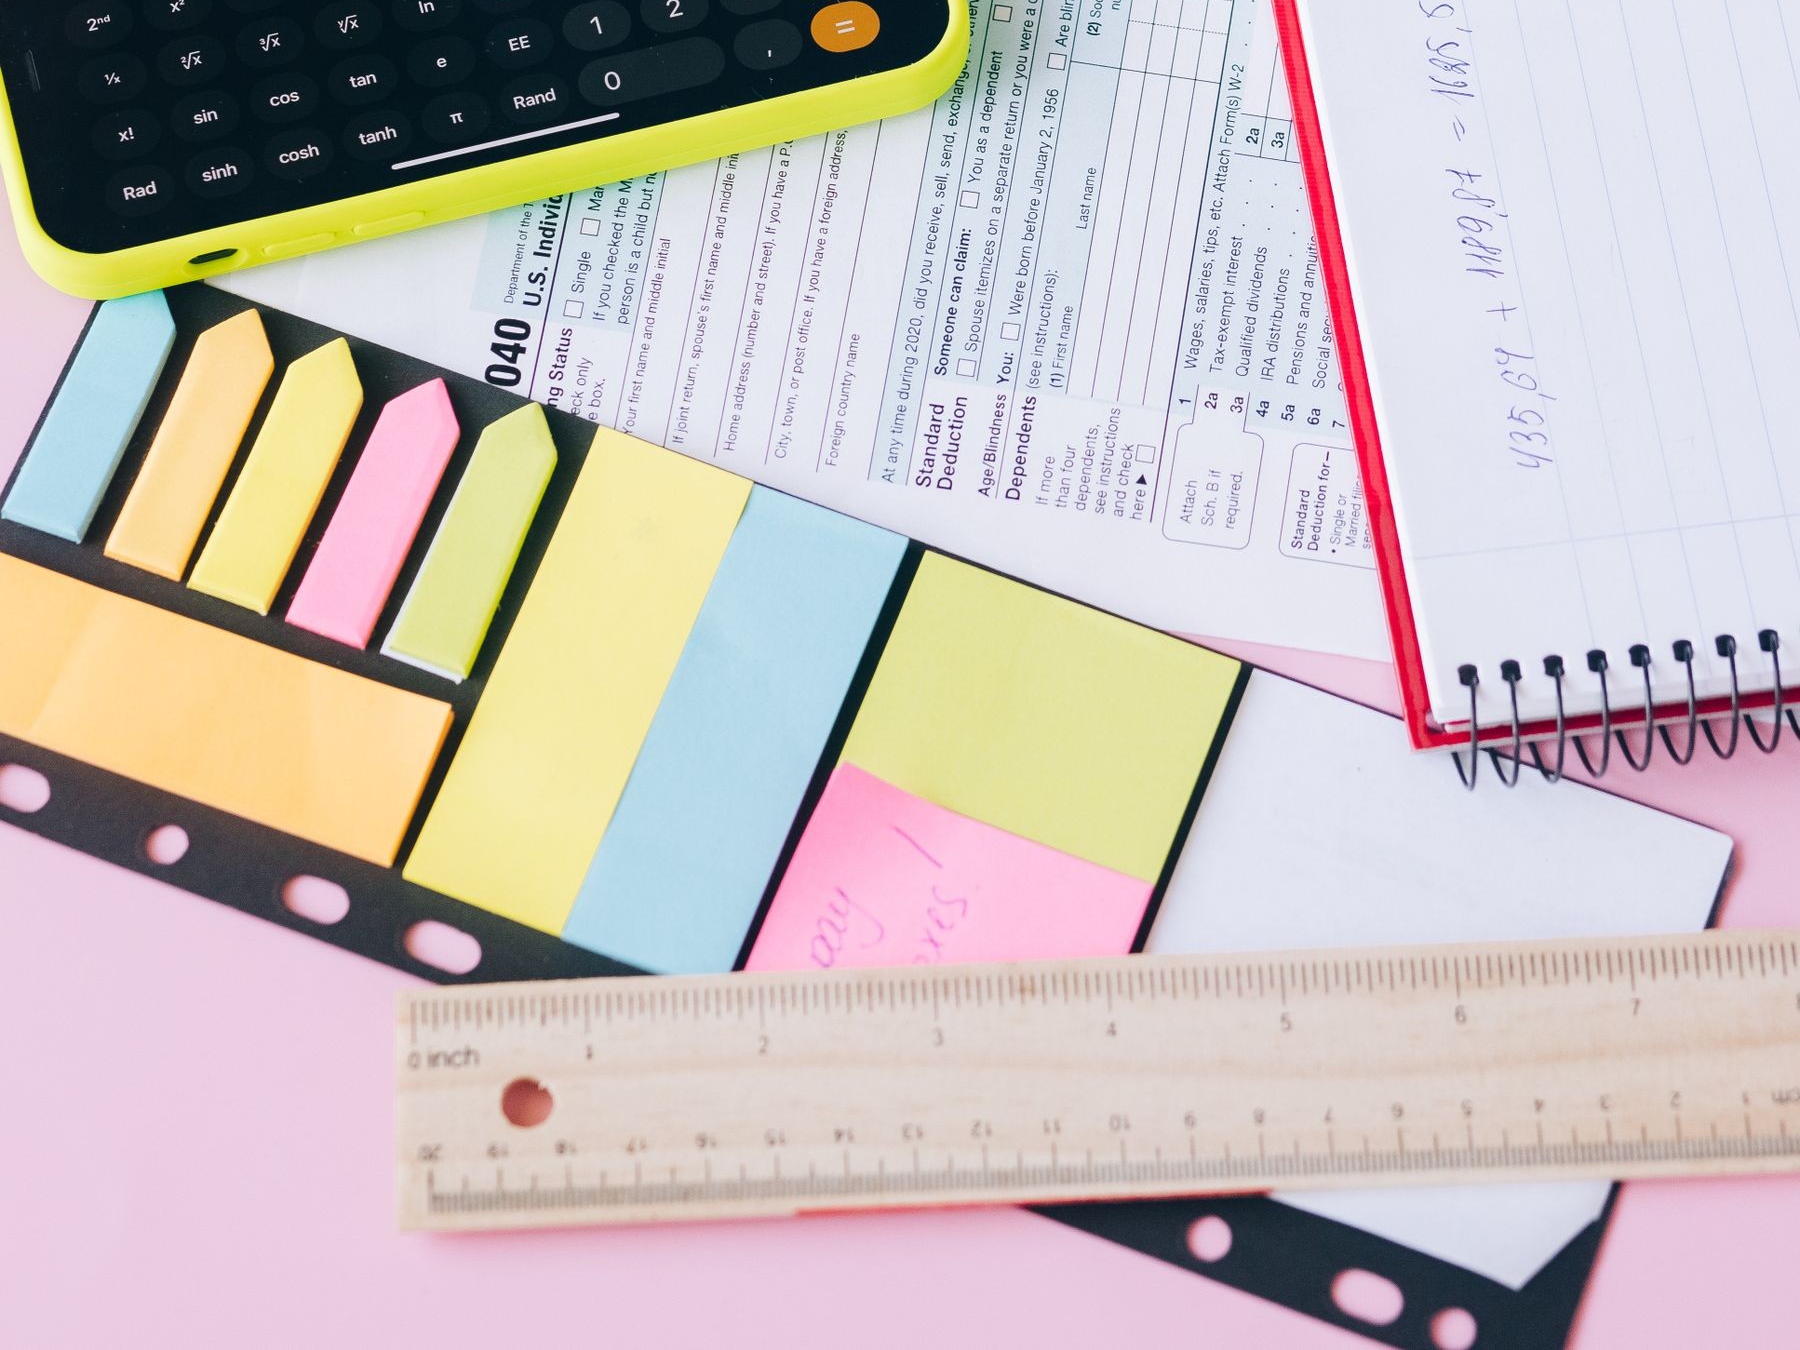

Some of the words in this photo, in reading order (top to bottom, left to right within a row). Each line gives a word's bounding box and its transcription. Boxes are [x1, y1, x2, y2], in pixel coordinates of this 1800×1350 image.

[418, 0, 435, 14] ln
[590, 16, 603, 35] 1
[1053, 23, 1071, 49] Are
[1085, 20, 1103, 37] (2)
[508, 35, 531, 52] EE
[436, 57, 447, 68] e
[1227, 63, 1245, 92] W-2
[349, 73, 377, 88] tan
[604, 71, 621, 91] 0
[269, 91, 300, 107] cos
[513, 87, 557, 110] Rand
[1041, 88, 1060, 121] 1956
[193, 109, 219, 125] sin
[1038, 125, 1055, 139] 2,
[1218, 94, 1243, 146] Form(s)
[1452, 116, 1469, 143] =
[118, 126, 135, 142] x!
[358, 126, 398, 145] tanh
[278, 144, 320, 164] cosh
[1028, 140, 1054, 196] January
[202, 163, 238, 182] sinh
[1082, 166, 1098, 202] name
[1211, 148, 1232, 194] Attach
[122, 180, 157, 201] Rad
[1020, 197, 1042, 242] before
[1074, 203, 1092, 231] Last
[1208, 196, 1224, 222] etc.
[952, 227, 973, 273] claim:
[1201, 225, 1222, 254] tips,
[570, 250, 593, 294] Single
[1014, 245, 1033, 278] born
[1222, 234, 1244, 288] interest
[521, 265, 549, 307] U.S.
[949, 275, 964, 303] can
[1194, 258, 1216, 315] salaries,
[1245, 245, 1269, 313] dividends
[1007, 279, 1030, 319] Were
[1029, 268, 1061, 358] instructions):
[1265, 267, 1291, 354] distributions
[1298, 291, 1313, 319] and
[1484, 299, 1518, 324] +
[1059, 305, 1075, 341] name
[1208, 290, 1237, 374] Tax-exempt
[845, 333, 861, 369] name
[933, 306, 959, 377] Someone
[1051, 342, 1069, 370] First
[1183, 318, 1207, 370] Wages,
[1234, 314, 1258, 378] Qualified
[1285, 321, 1309, 386] Pensions
[995, 351, 1015, 385] You:
[1024, 359, 1043, 390] (see
[1048, 372, 1066, 389] (1)
[1259, 356, 1278, 382] IRA
[1310, 349, 1331, 390] Social
[836, 369, 857, 418] country
[1177, 397, 1192, 405] 1
[1203, 391, 1219, 411] 2a
[1229, 395, 1245, 415] 3a
[1254, 399, 1271, 419] 4a
[1279, 403, 1296, 422] 5a
[824, 419, 847, 467] Foreign
[914, 402, 946, 488] Standard
[935, 396, 969, 491] Deduction
[976, 393, 1008, 498] Age/Blindness
[1004, 395, 1038, 502] Dependents
[1058, 443, 1077, 474] four
[1095, 406, 1122, 487] instructions
[1039, 455, 1057, 494] more
[1073, 423, 1102, 512] dependents,
[1207, 467, 1222, 479] if
[1034, 494, 1049, 506] If
[1054, 476, 1072, 509] than
[1093, 489, 1109, 515] see
[1178, 479, 1198, 525] Attach
[1204, 481, 1220, 493] B
[1224, 470, 1244, 530] required.
[1199, 496, 1218, 527] Sch.
[759, 1036, 769, 1055] 2
[936, 1028, 945, 1047] 3
[1107, 1022, 1117, 1037] 4
[1280, 1013, 1292, 1031] 5
[1454, 1006, 1467, 1023] 6
[1633, 997, 1641, 1016] 7
[410, 1052, 420, 1069] 0
[427, 1048, 479, 1068] inch
